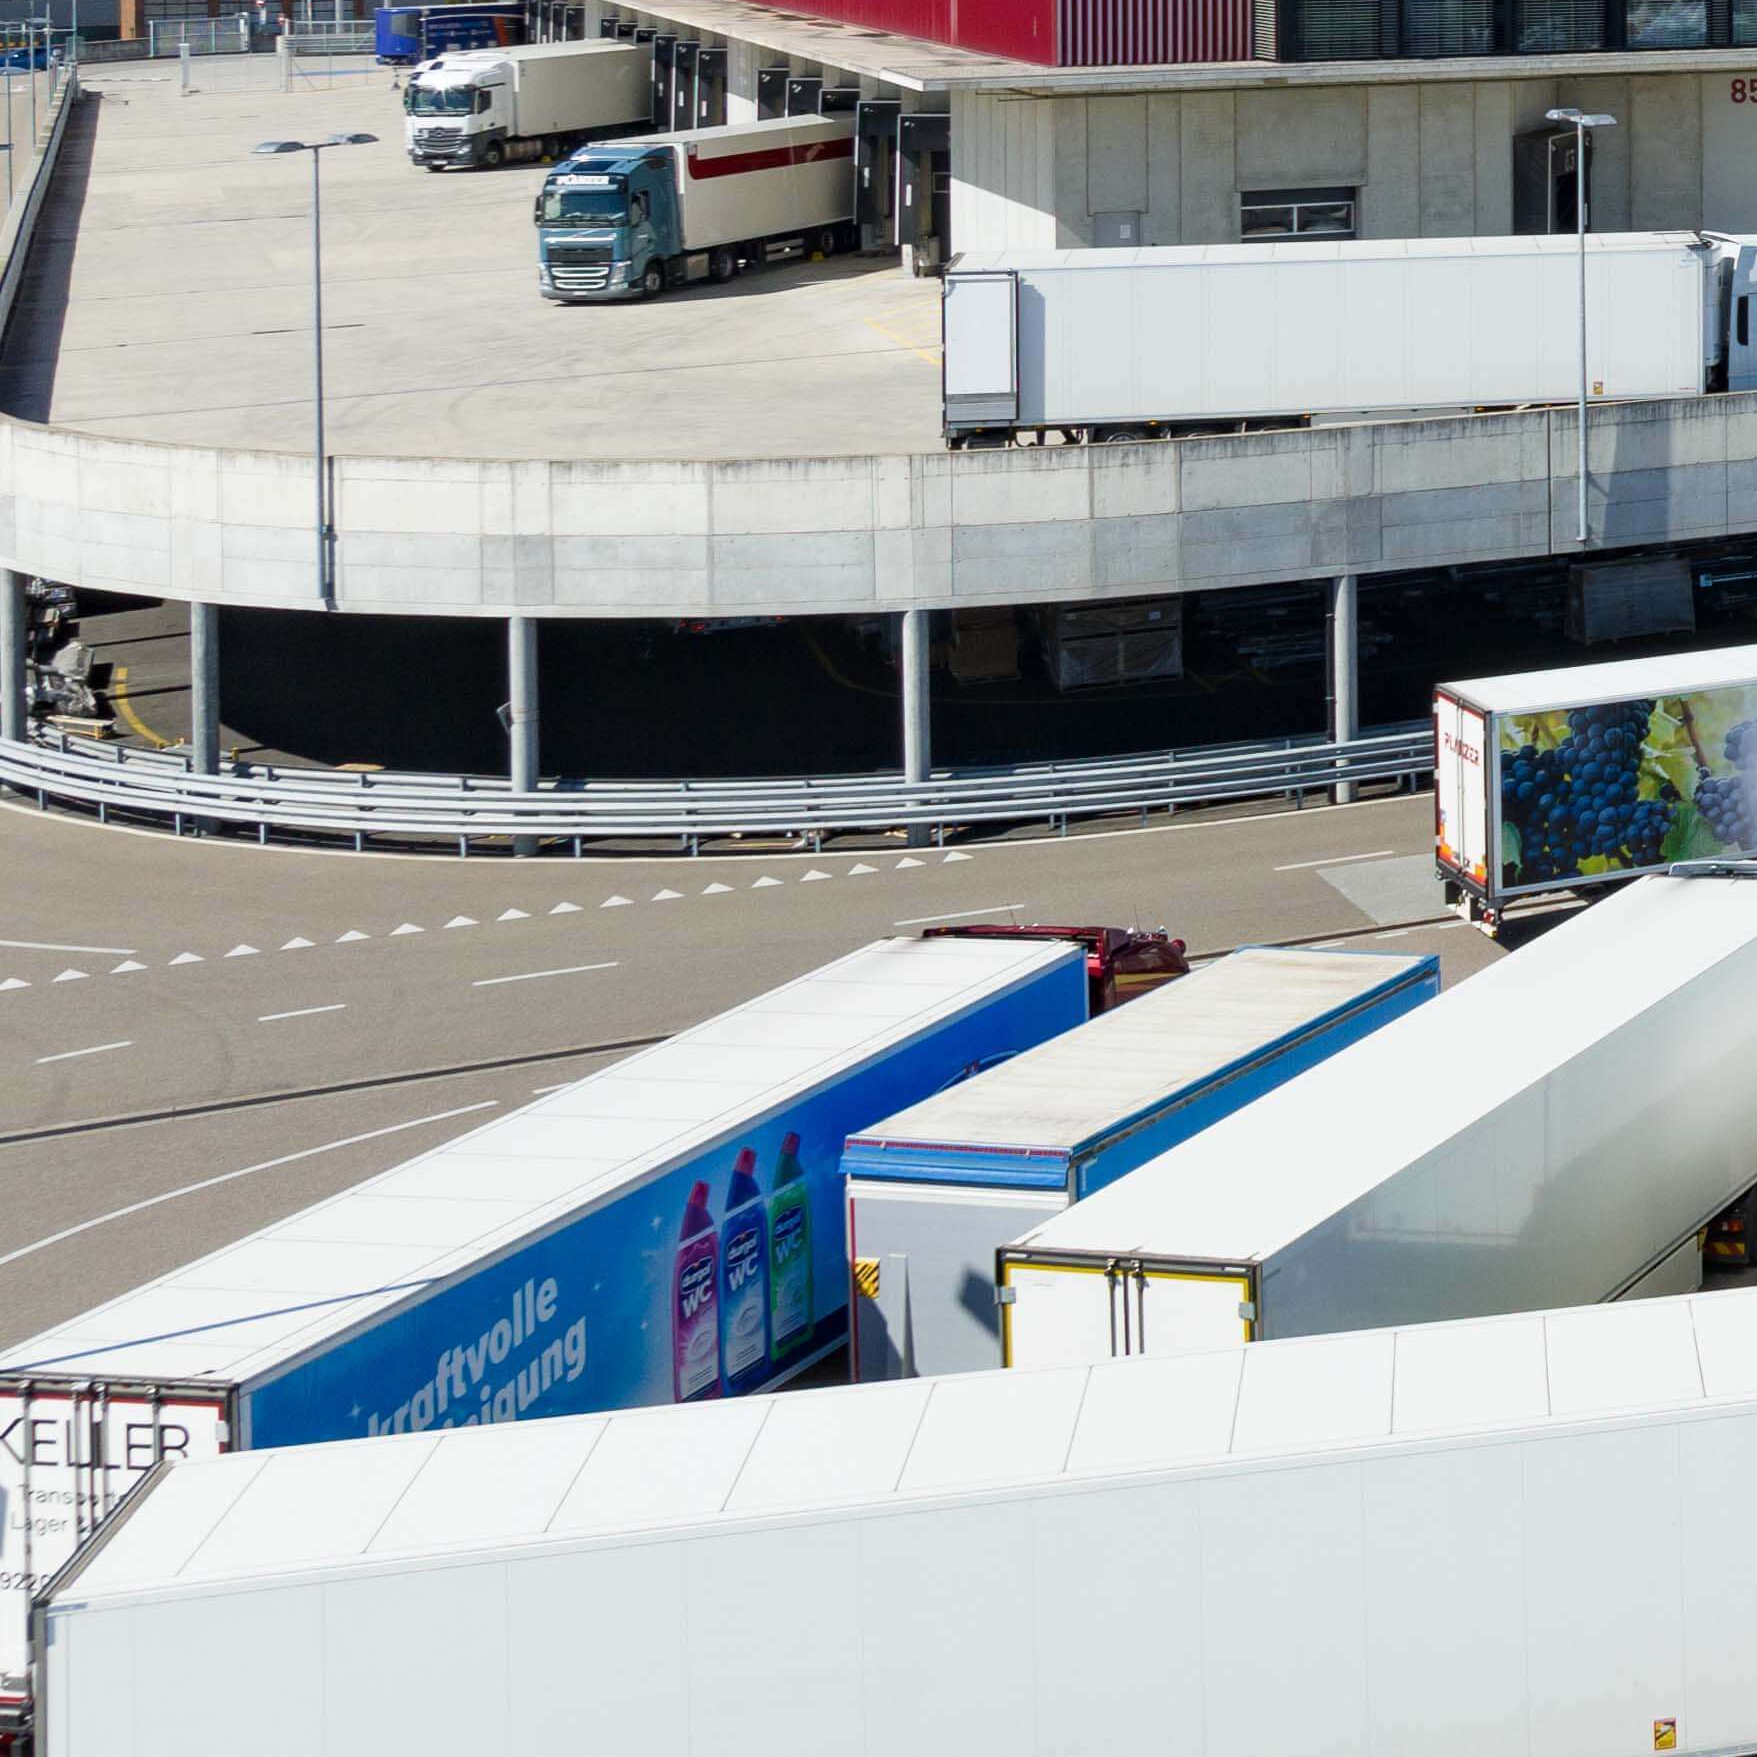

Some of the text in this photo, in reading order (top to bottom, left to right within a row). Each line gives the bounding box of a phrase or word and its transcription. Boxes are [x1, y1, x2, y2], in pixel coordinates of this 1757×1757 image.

[729, 1253, 759, 1291] WC
[682, 1281, 713, 1319] WC
[367, 1277, 559, 1438] kraftvolle
[0, 1416, 190, 1471] KELLER
